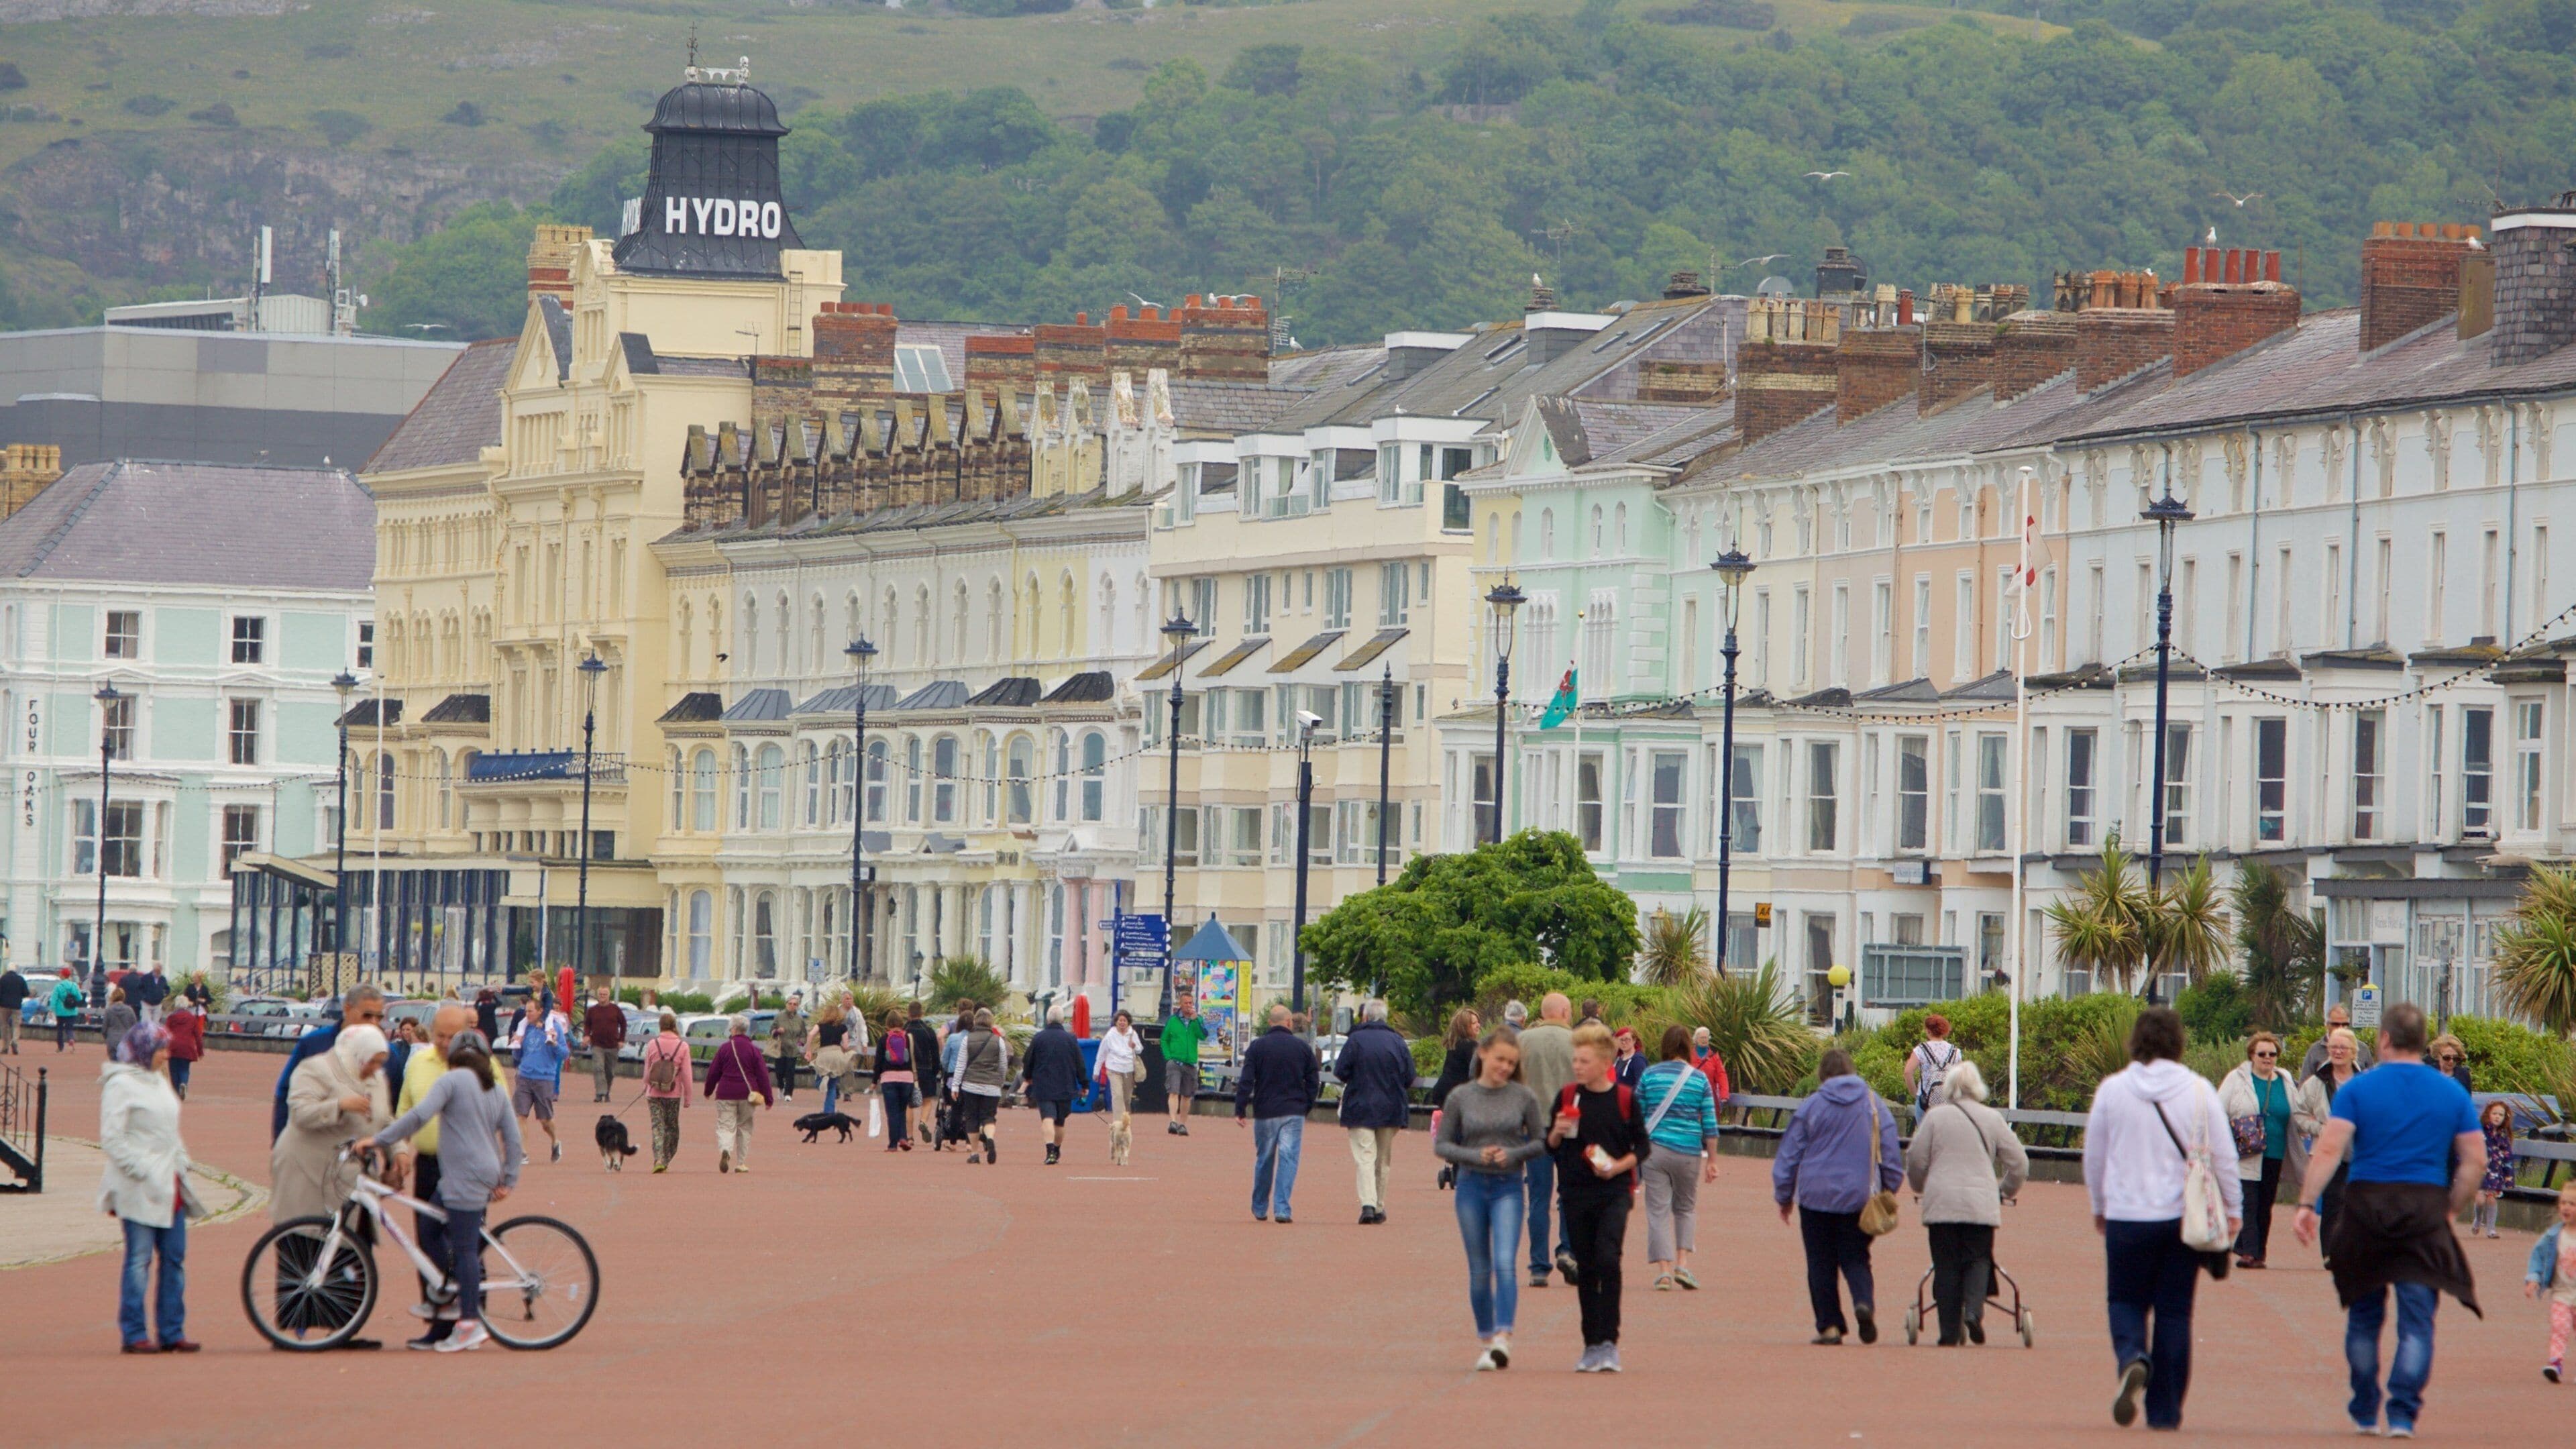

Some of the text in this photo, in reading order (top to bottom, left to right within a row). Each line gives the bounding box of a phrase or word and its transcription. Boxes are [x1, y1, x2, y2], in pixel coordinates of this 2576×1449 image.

[621, 197, 641, 236] HYDR
[665, 197, 780, 239] HYDRO
[25, 700, 38, 826] FOUR OAKS
[2364, 991, 2371, 999] P
